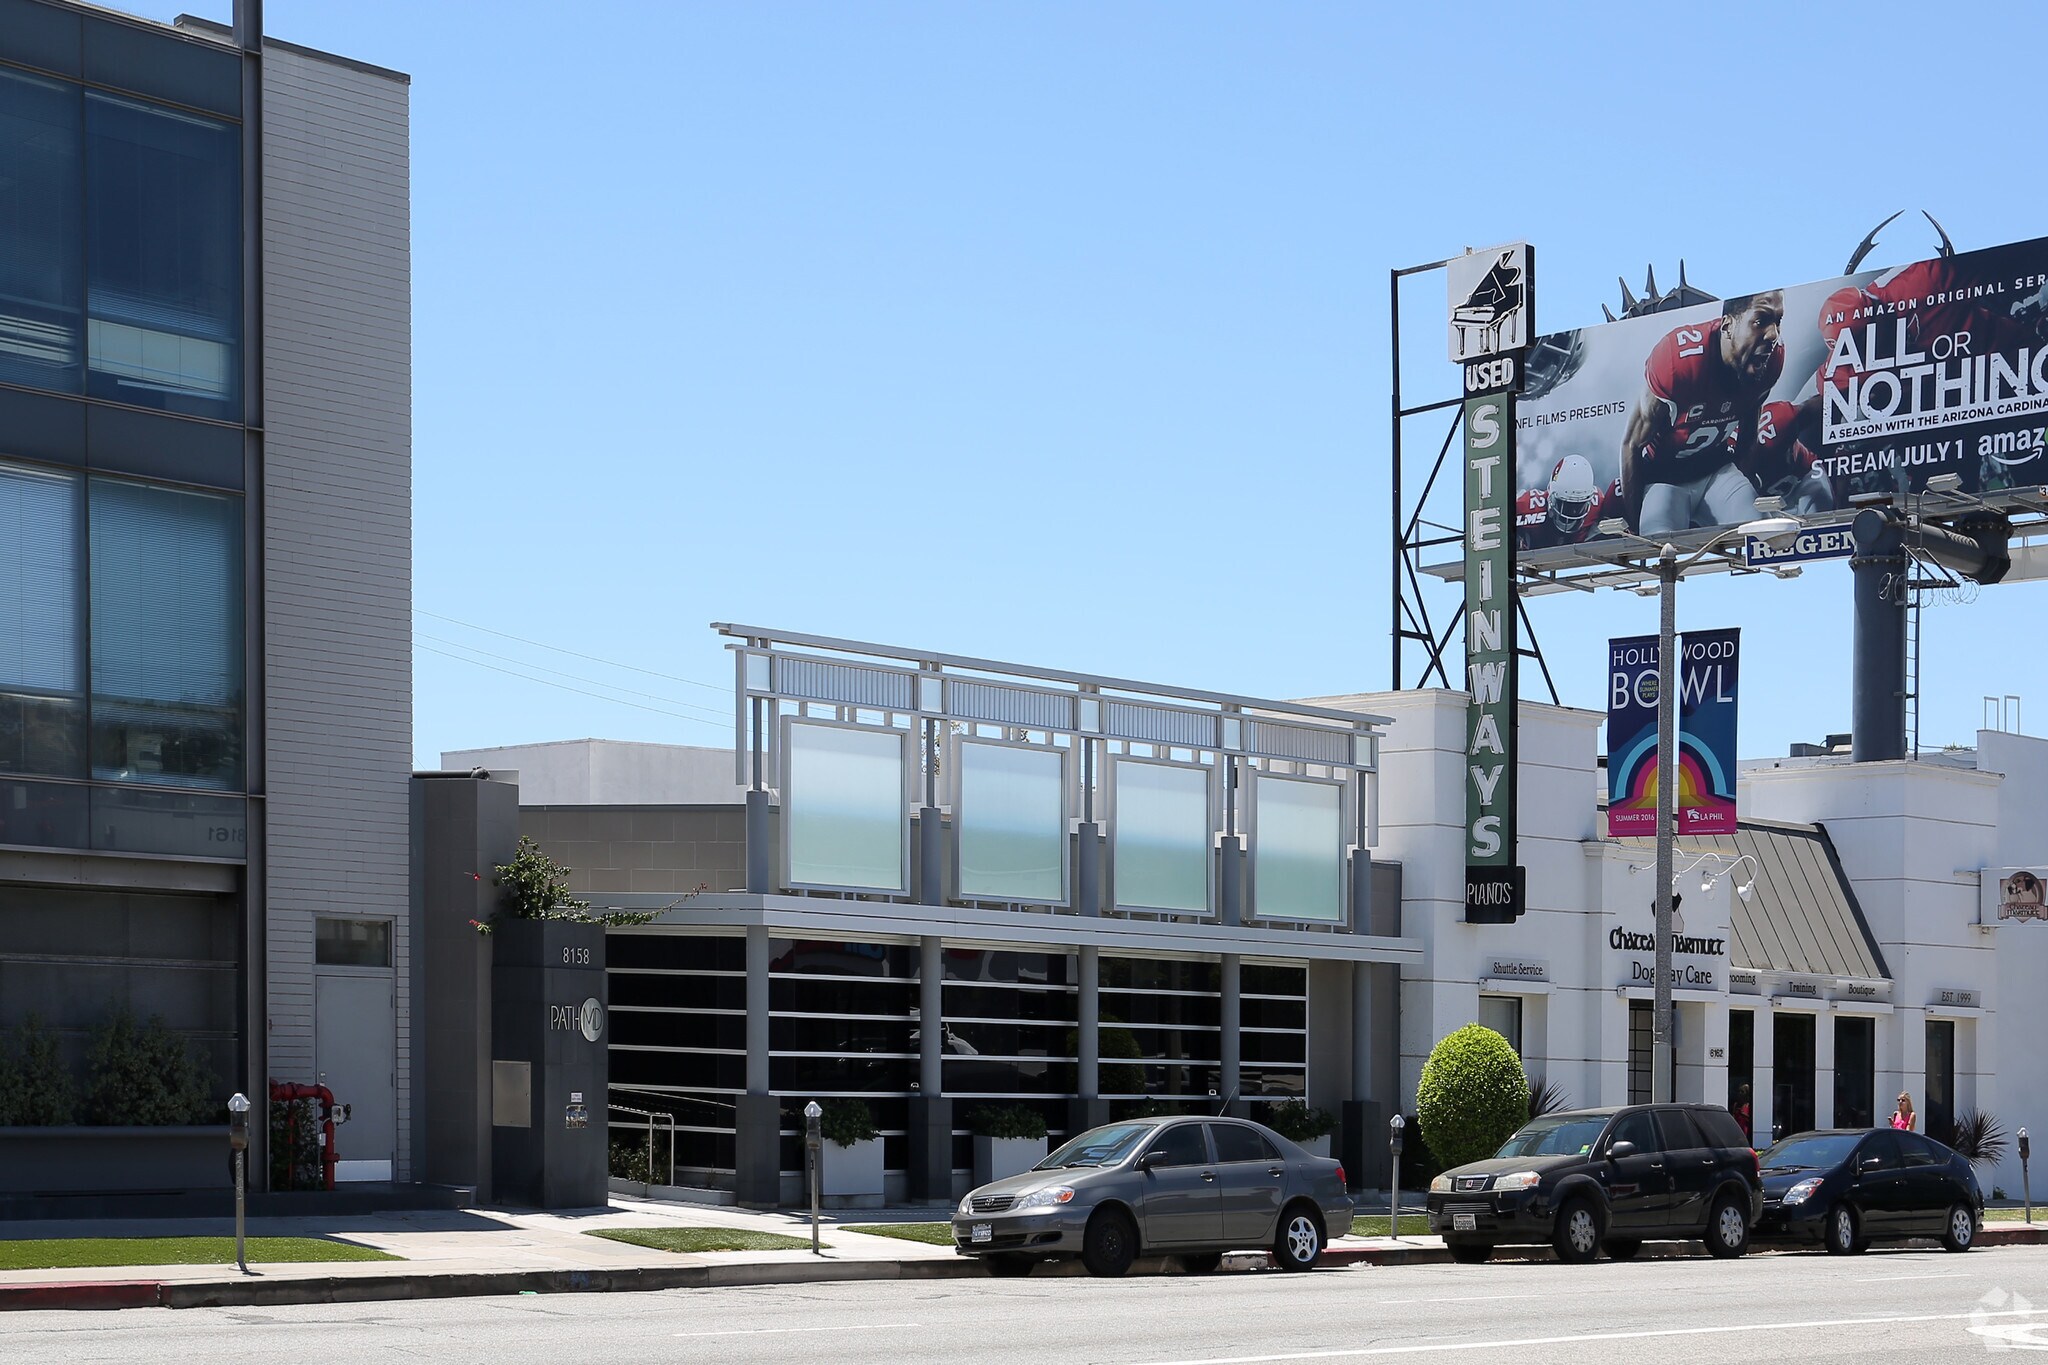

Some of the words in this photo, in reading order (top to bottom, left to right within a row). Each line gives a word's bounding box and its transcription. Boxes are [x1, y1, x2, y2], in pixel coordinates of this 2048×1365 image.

[1825, 312, 1845, 325] AN
[1852, 298, 1917, 320] AMAZON
[1926, 282, 2005, 305] ORIGINAL
[2014, 274, 2046, 290] SER
[1824, 317, 1926, 379] ALL
[1931, 331, 1972, 360] OR
[1465, 357, 1515, 393] USED
[1536, 409, 1567, 427] FILMS
[1569, 401, 1626, 420] PRESENTS
[1829, 430, 1837, 440] A
[1839, 424, 1882, 439] SEASON
[1886, 419, 1915, 433] WITH
[1918, 415, 1939, 428] THE
[1941, 407, 1994, 424] ARIZONA
[1977, 426, 2048, 457] amaz
[1810, 449, 1895, 480] STREAM
[1901, 440, 1951, 468] JULY
[1955, 439, 1964, 460] 1
[1750, 531, 1857, 560] RGEN
[1468, 404, 1507, 858] STEINWAYS
[1615, 813, 1640, 822] SUMMER
[1641, 813, 1655, 821] 2016
[1700, 812, 1708, 821] LA
[1709, 812, 1724, 820] PHIL
[1467, 882, 1513, 905] PIANOS
[1609, 926, 1657, 952] Chatea
[563, 947, 590, 965] 8158
[1493, 961, 1517, 975] Shuttle
[1519, 963, 1543, 976] Service
[1671, 970, 1683, 986] ay
[1685, 965, 1712, 985] Care
[1729, 973, 1756, 985] rooming
[1789, 982, 1816, 995] Training
[1848, 984, 1876, 997] Boutique
[1957, 992, 1972, 1003] 1999
